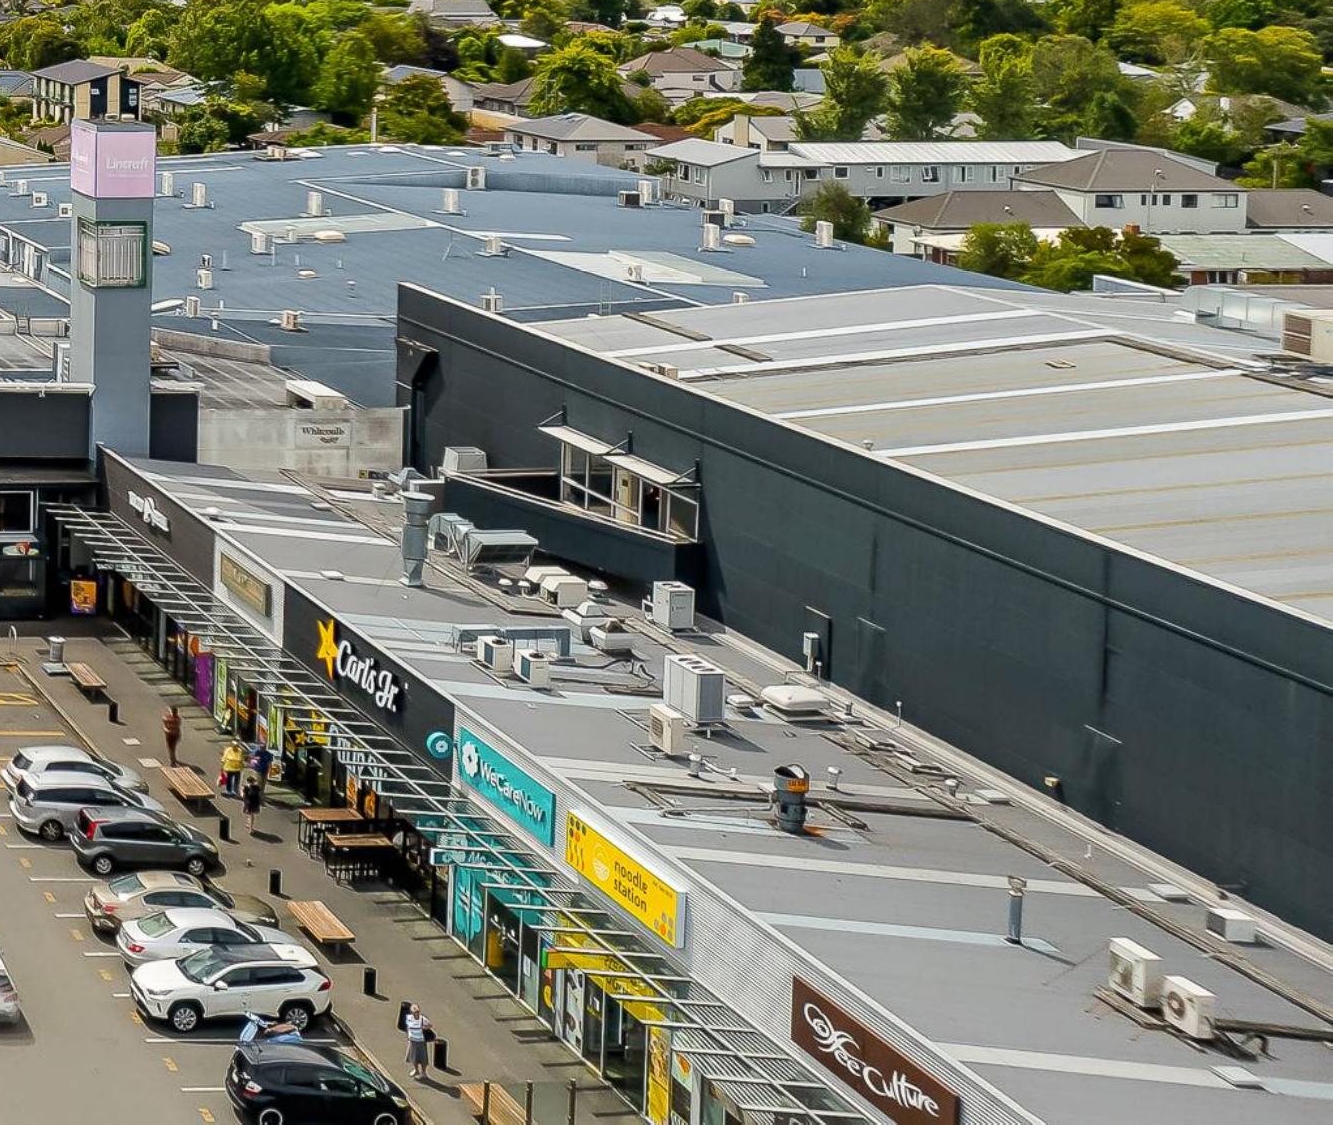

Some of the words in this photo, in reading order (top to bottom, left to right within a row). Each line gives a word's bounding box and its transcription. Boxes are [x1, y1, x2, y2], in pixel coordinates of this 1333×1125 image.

[336, 639, 377, 695] Carl's
[375, 669, 400, 713] Jr.
[479, 759, 543, 823] WeCareNow
[613, 878, 647, 913] station
[614, 860, 649, 895] noodle
[803, 1002, 867, 1077] Coffee
[862, 1065, 941, 1118] Culture
